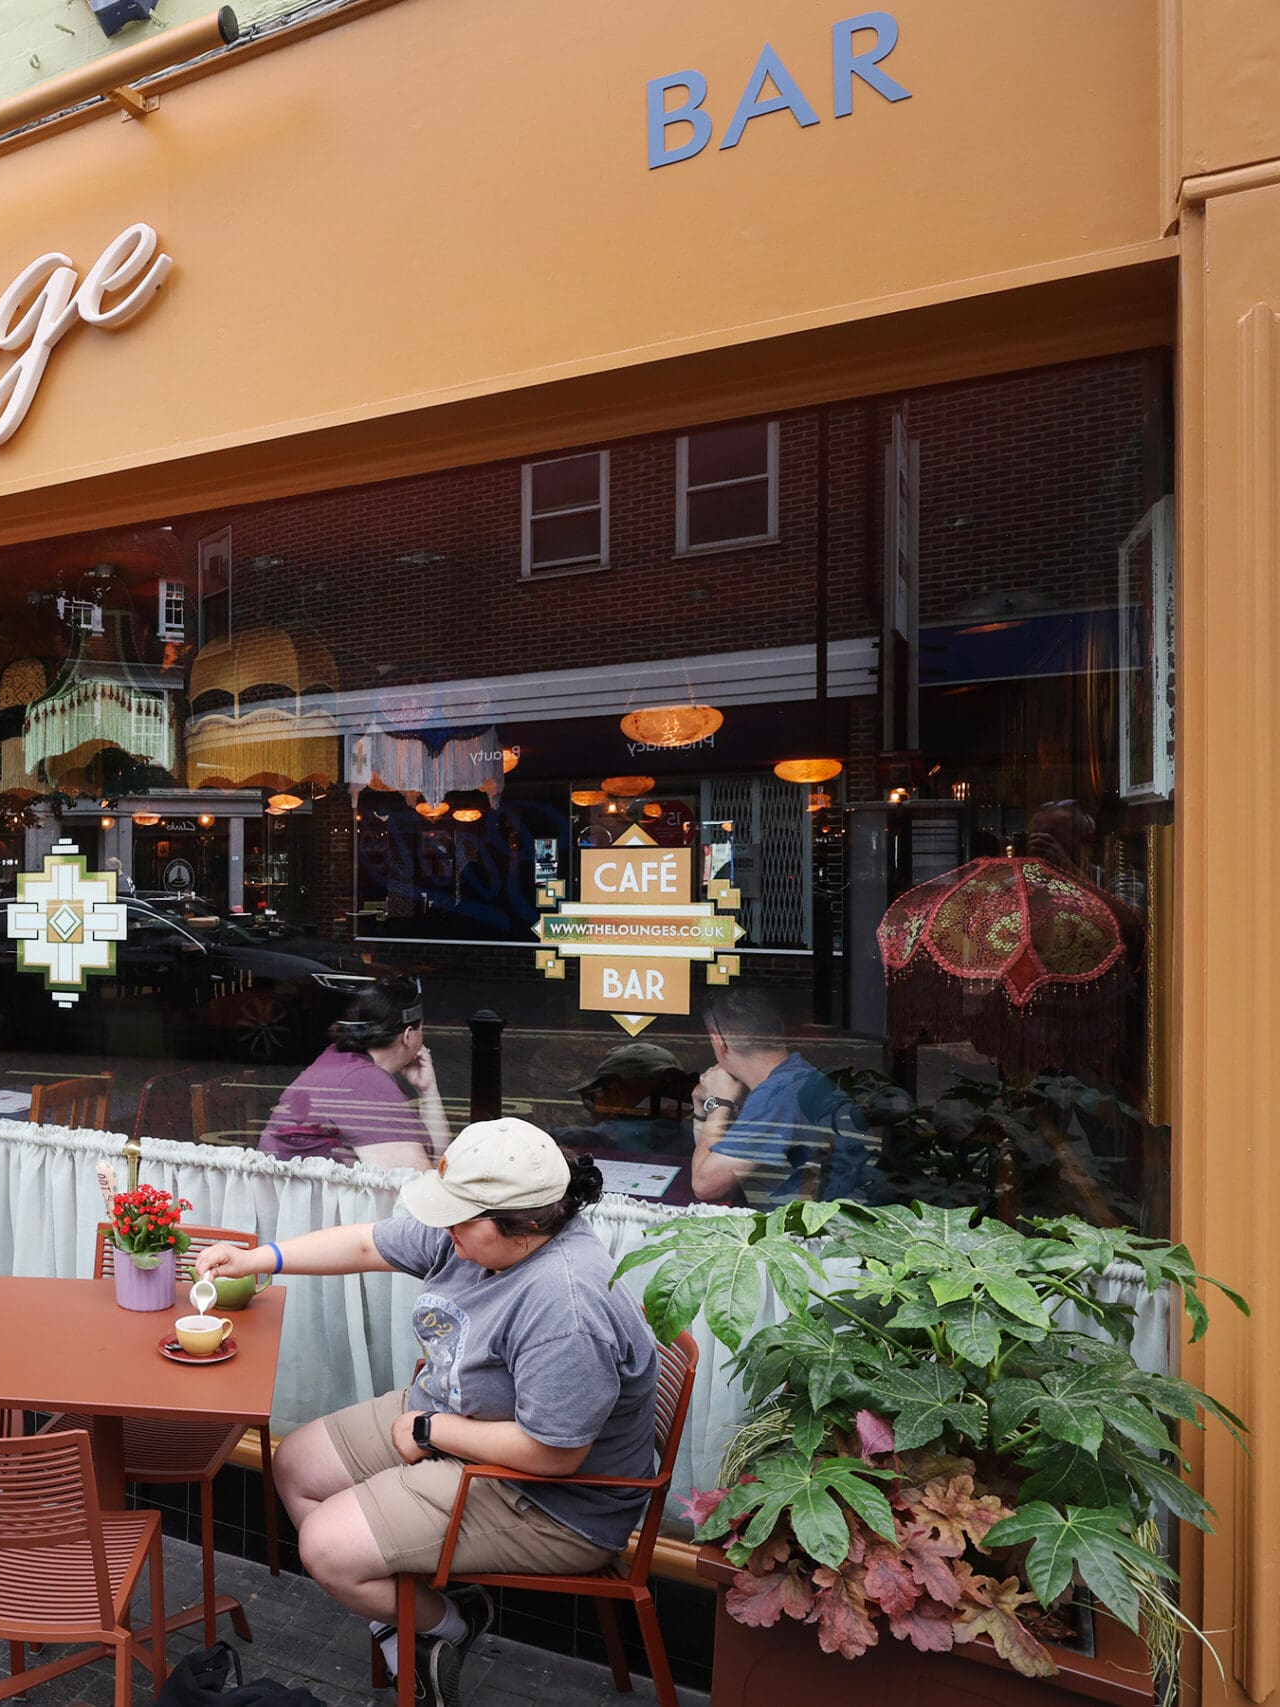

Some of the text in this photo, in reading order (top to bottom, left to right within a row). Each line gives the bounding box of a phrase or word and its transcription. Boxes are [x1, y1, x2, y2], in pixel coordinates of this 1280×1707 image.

[647, 11, 912, 170] BAR
[593, 853, 677, 893] CAFÉ
[550, 923, 724, 938] WWW.THELOUNGES.CO.UK
[602, 967, 665, 1000] BAR
